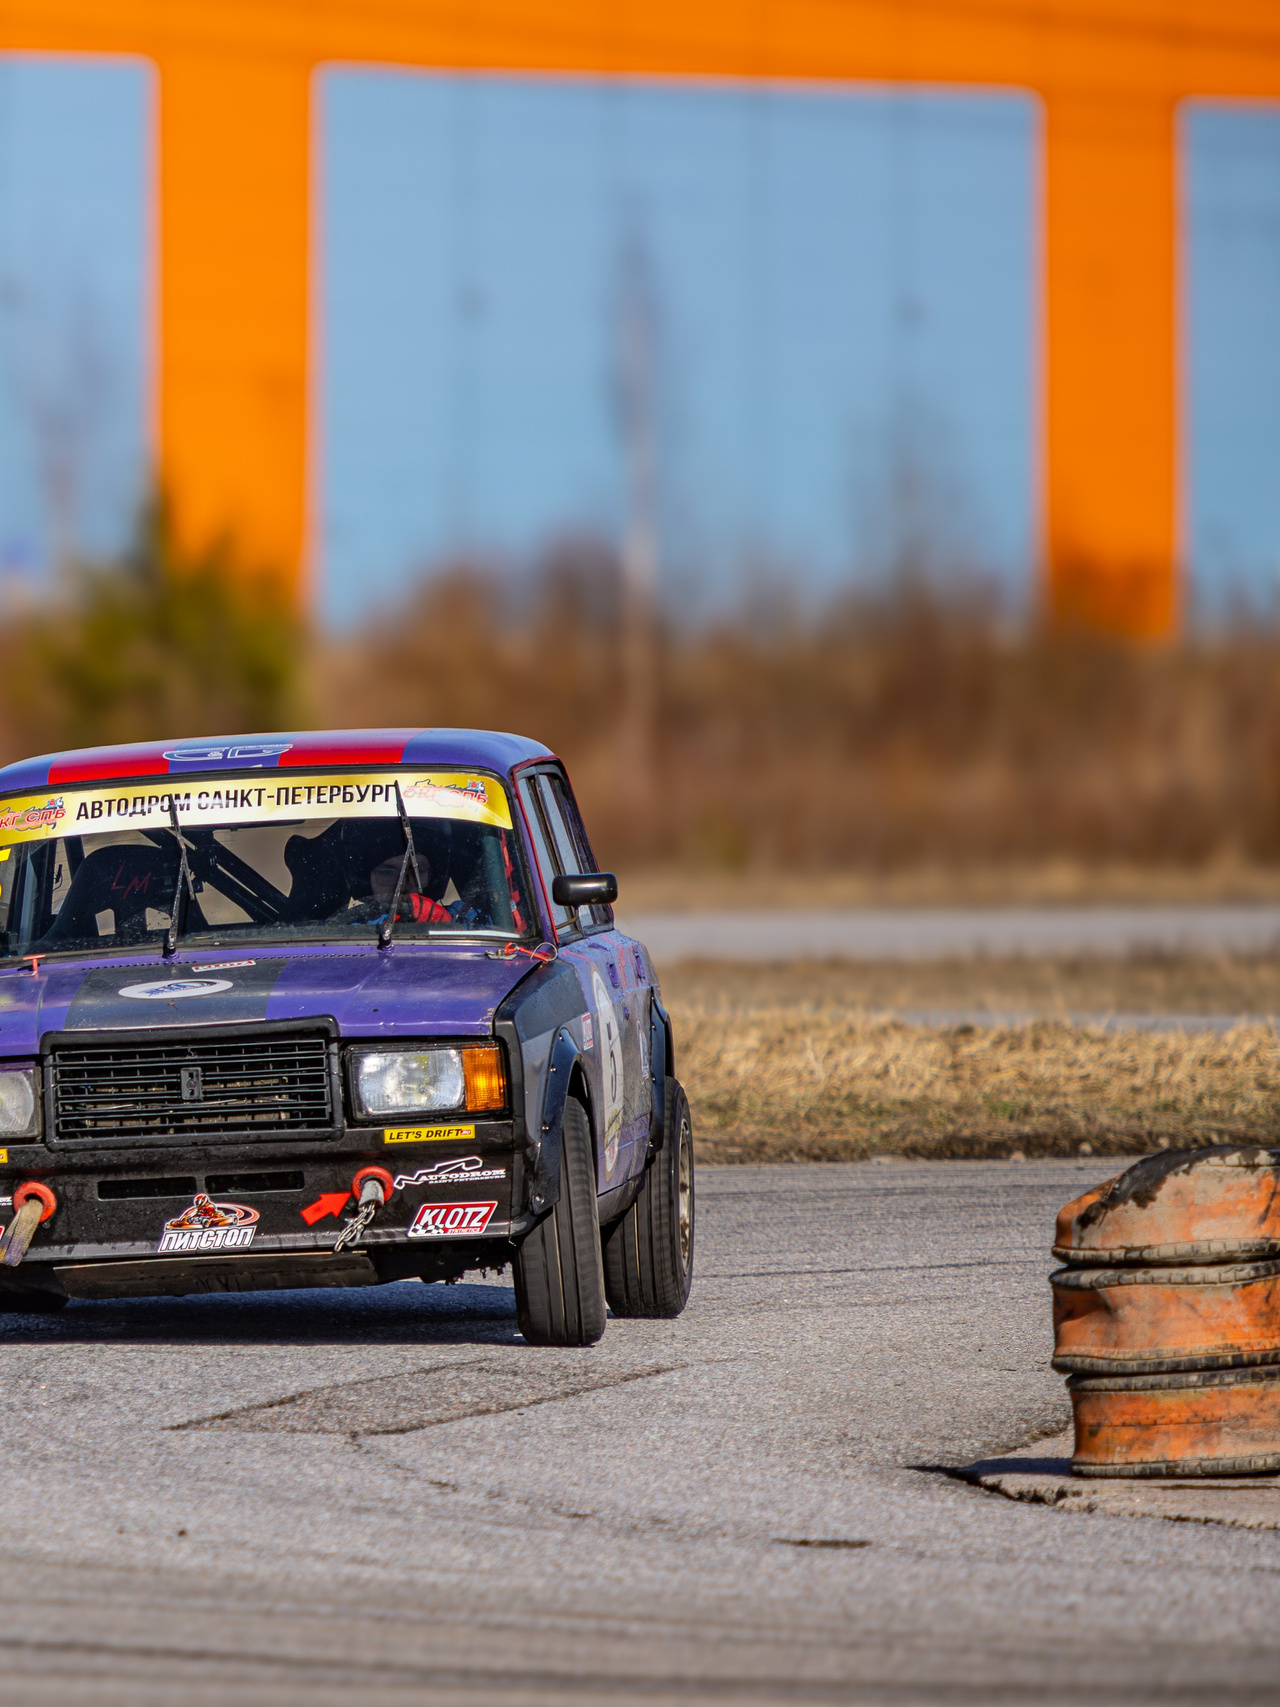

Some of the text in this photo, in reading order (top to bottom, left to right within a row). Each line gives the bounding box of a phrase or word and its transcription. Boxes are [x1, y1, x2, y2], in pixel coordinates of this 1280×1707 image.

[76, 784, 398, 821] АВТОДРОМ САНКТ-ПЕТЕРБУРГ
[25, 807, 67, 824] СПБ
[389, 1131, 422, 1140] LET'S
[418, 1169, 507, 1182] AUTODROM
[420, 1206, 491, 1229] KLOTZ
[159, 1227, 254, 1251] ПИТСТОП
